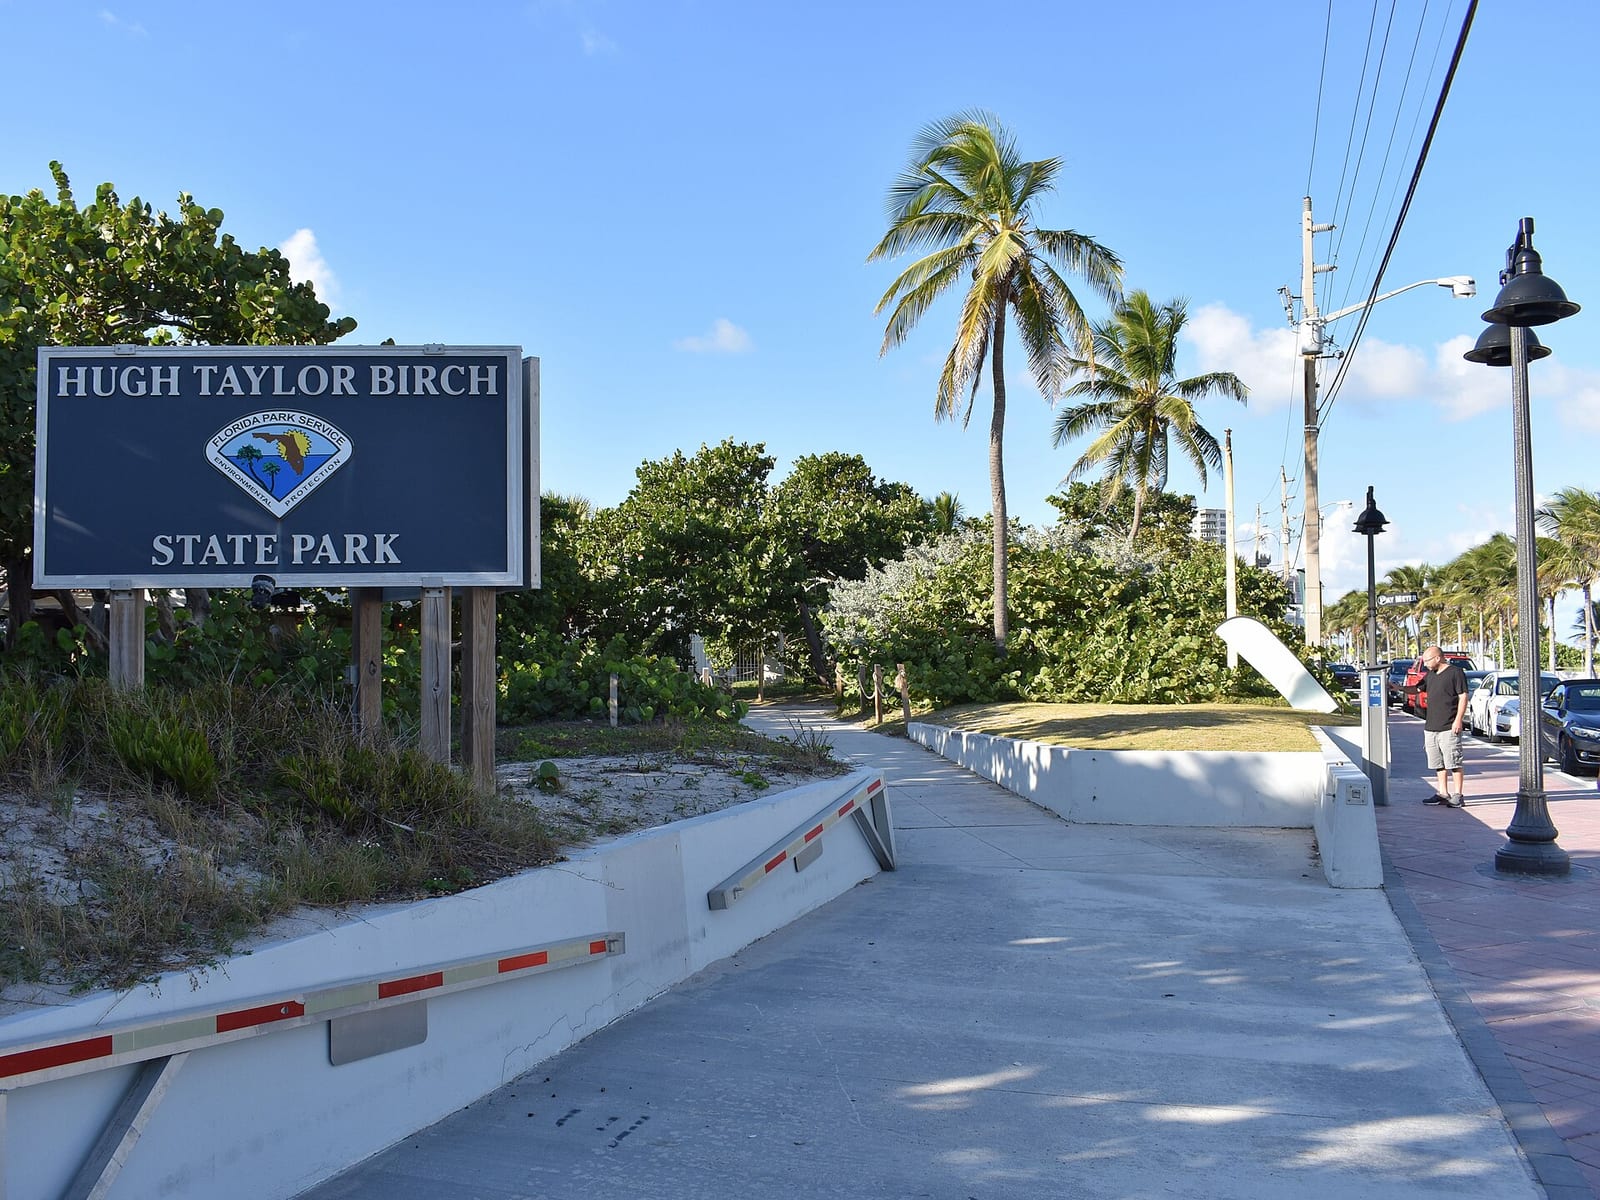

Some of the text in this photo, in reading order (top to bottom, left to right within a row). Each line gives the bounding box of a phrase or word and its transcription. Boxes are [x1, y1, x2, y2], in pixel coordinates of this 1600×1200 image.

[57, 365, 499, 397] HUGH TAYLOR BIRCH
[212, 413, 346, 447] FLORIDA PARK SERVICE
[214, 456, 341, 508] ENVIRONMENTAL PROTECTION
[151, 533, 401, 566] STATE PARK
[1370, 677, 1380, 690] P
